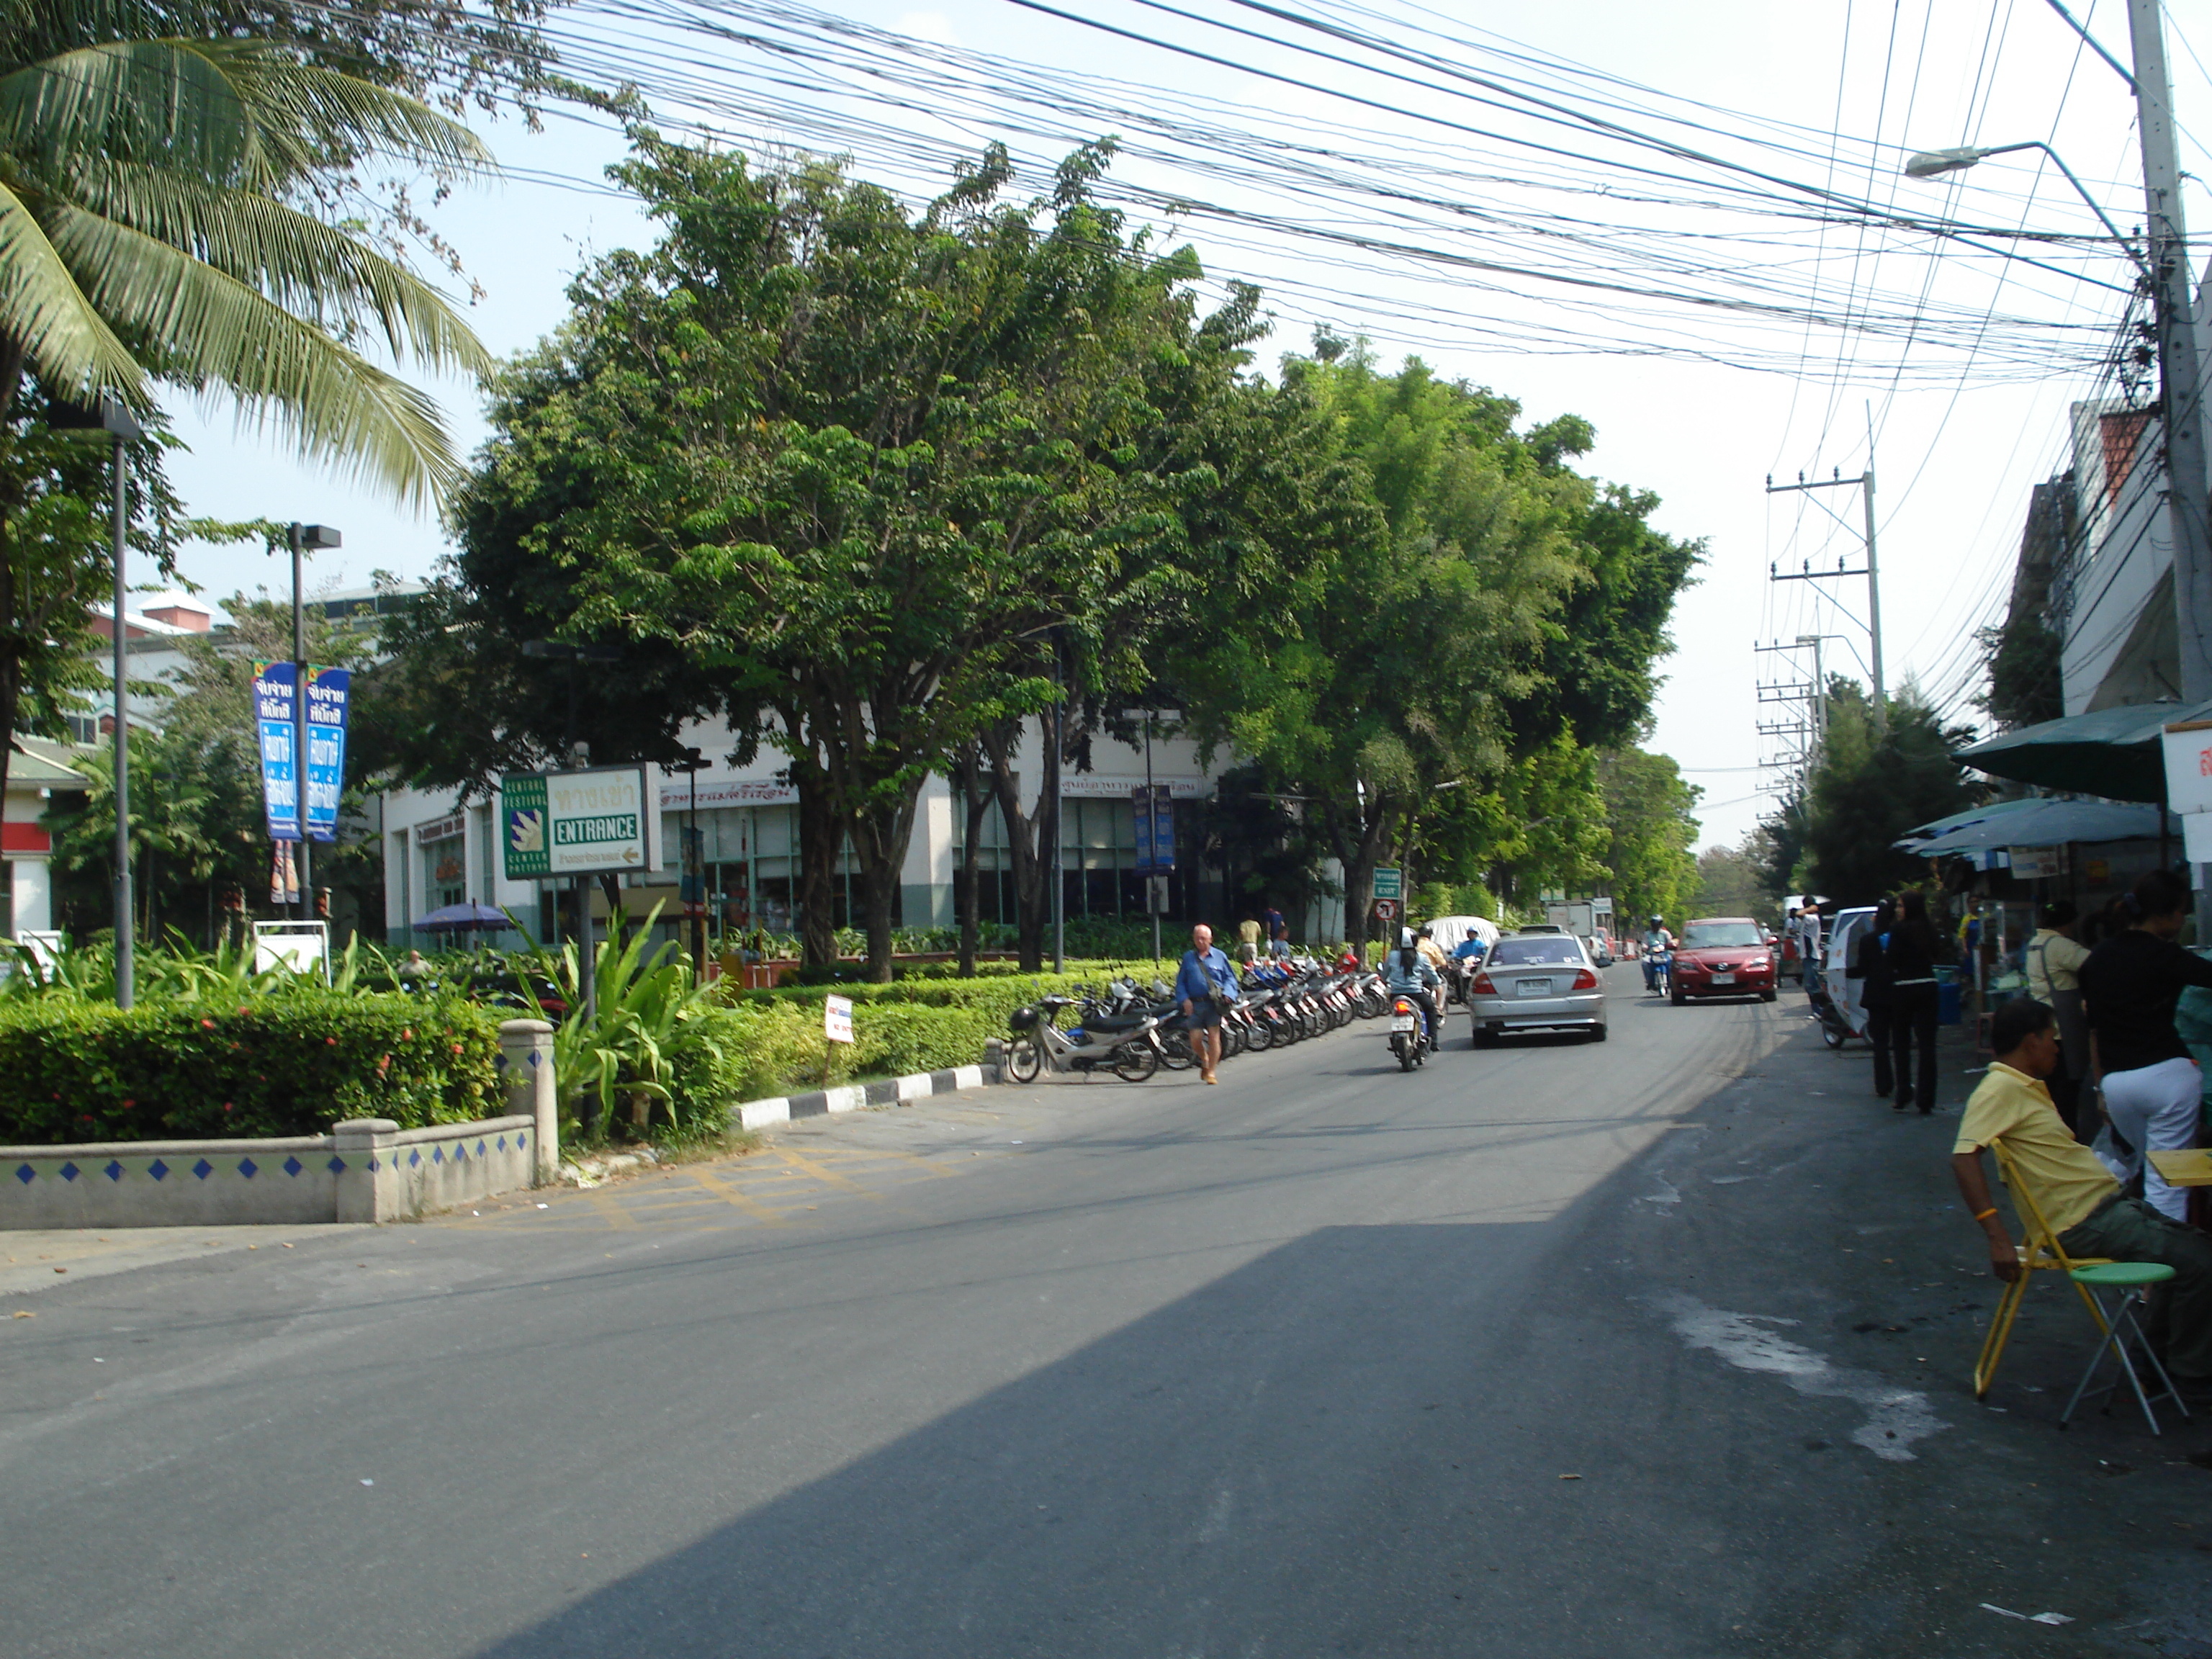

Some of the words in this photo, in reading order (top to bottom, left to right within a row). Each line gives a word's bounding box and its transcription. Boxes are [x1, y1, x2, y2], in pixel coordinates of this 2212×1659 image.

[255, 679, 292, 697] จับจ่าย
[307, 685, 344, 704] จับจ่าย
[260, 697, 290, 719] ที่บิ๊กซี
[310, 703, 341, 725] ที่บิ๊กซี
[505, 780, 545, 793] CENTRAL
[554, 773, 635, 811] ทางเข้า
[504, 794, 547, 809] FESTIVAL
[557, 816, 636, 843] ENTRANCE
[508, 853, 547, 863] CENTER
